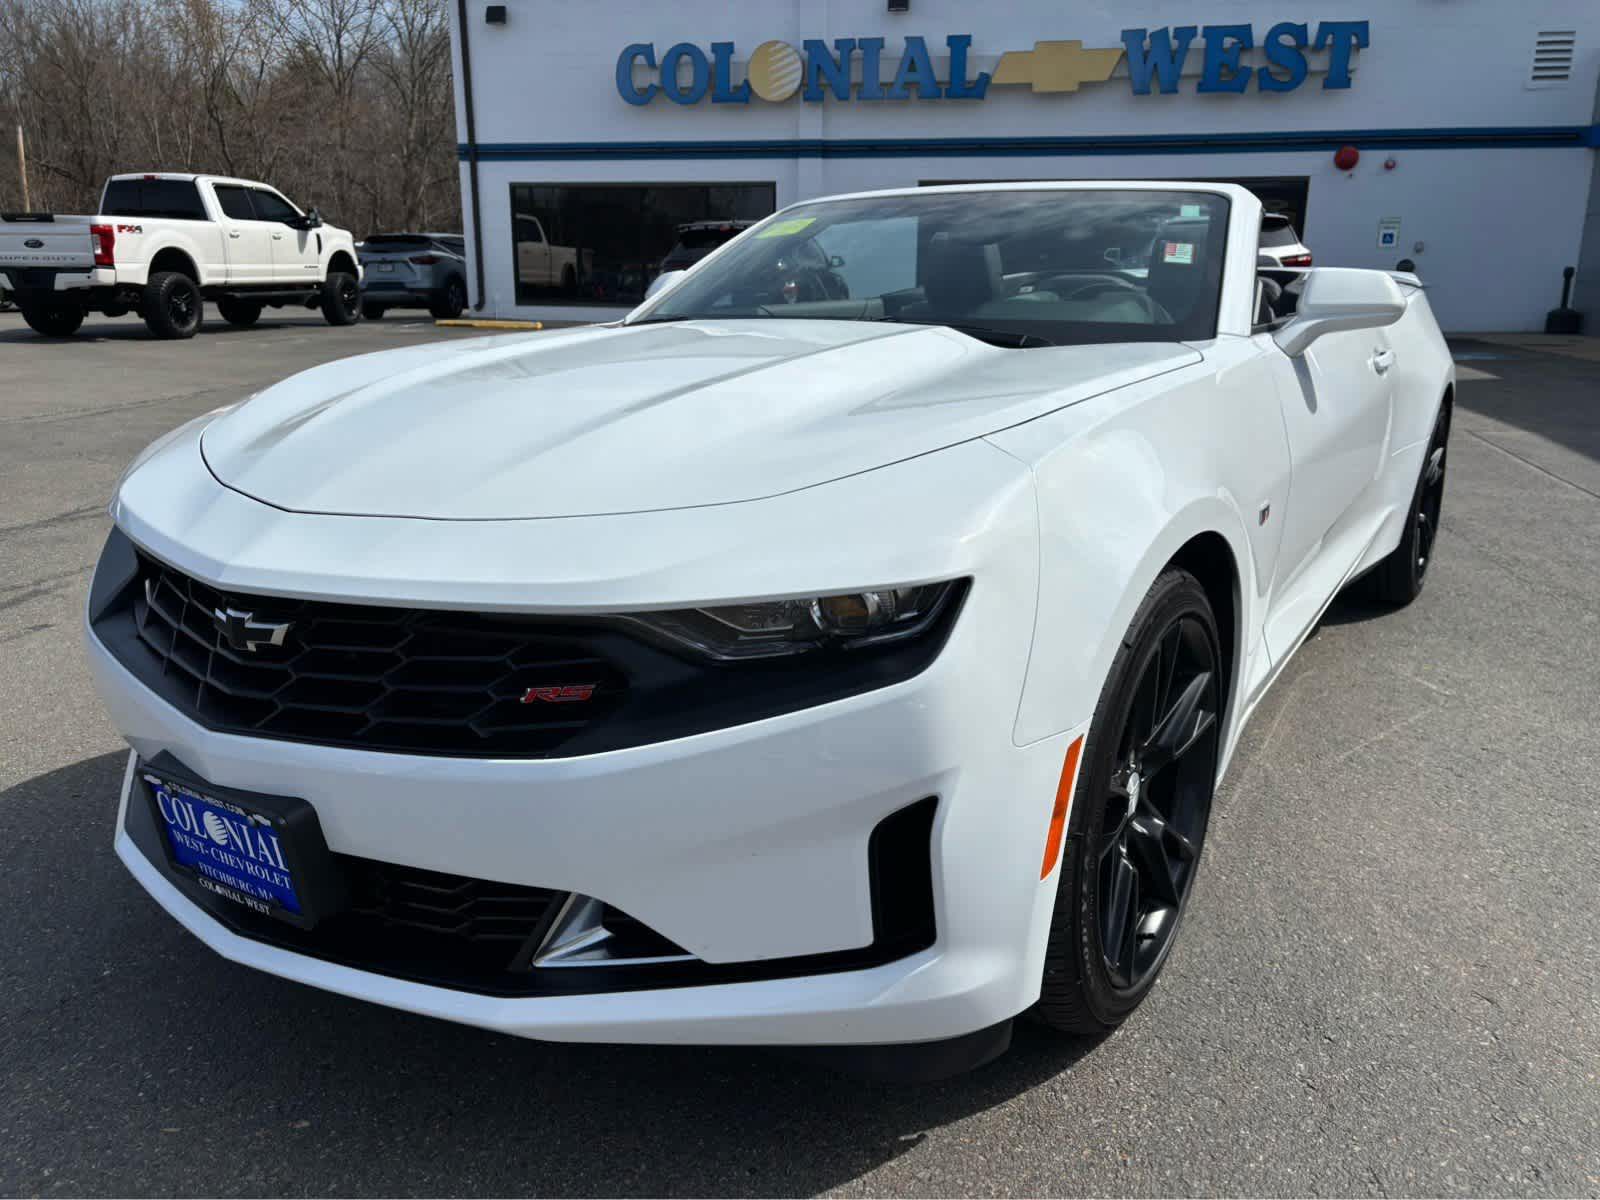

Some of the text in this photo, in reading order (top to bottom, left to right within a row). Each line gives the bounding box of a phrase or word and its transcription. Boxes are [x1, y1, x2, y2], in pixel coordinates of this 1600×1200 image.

[615, 20, 1369, 105] COLONIAL WEST
[117, 224, 143, 234] FX4
[520, 684, 596, 704] RS
[156, 791, 290, 872] COLONIAL
[210, 847, 292, 890] CHEVROLET
[244, 896, 270, 916] WEST
